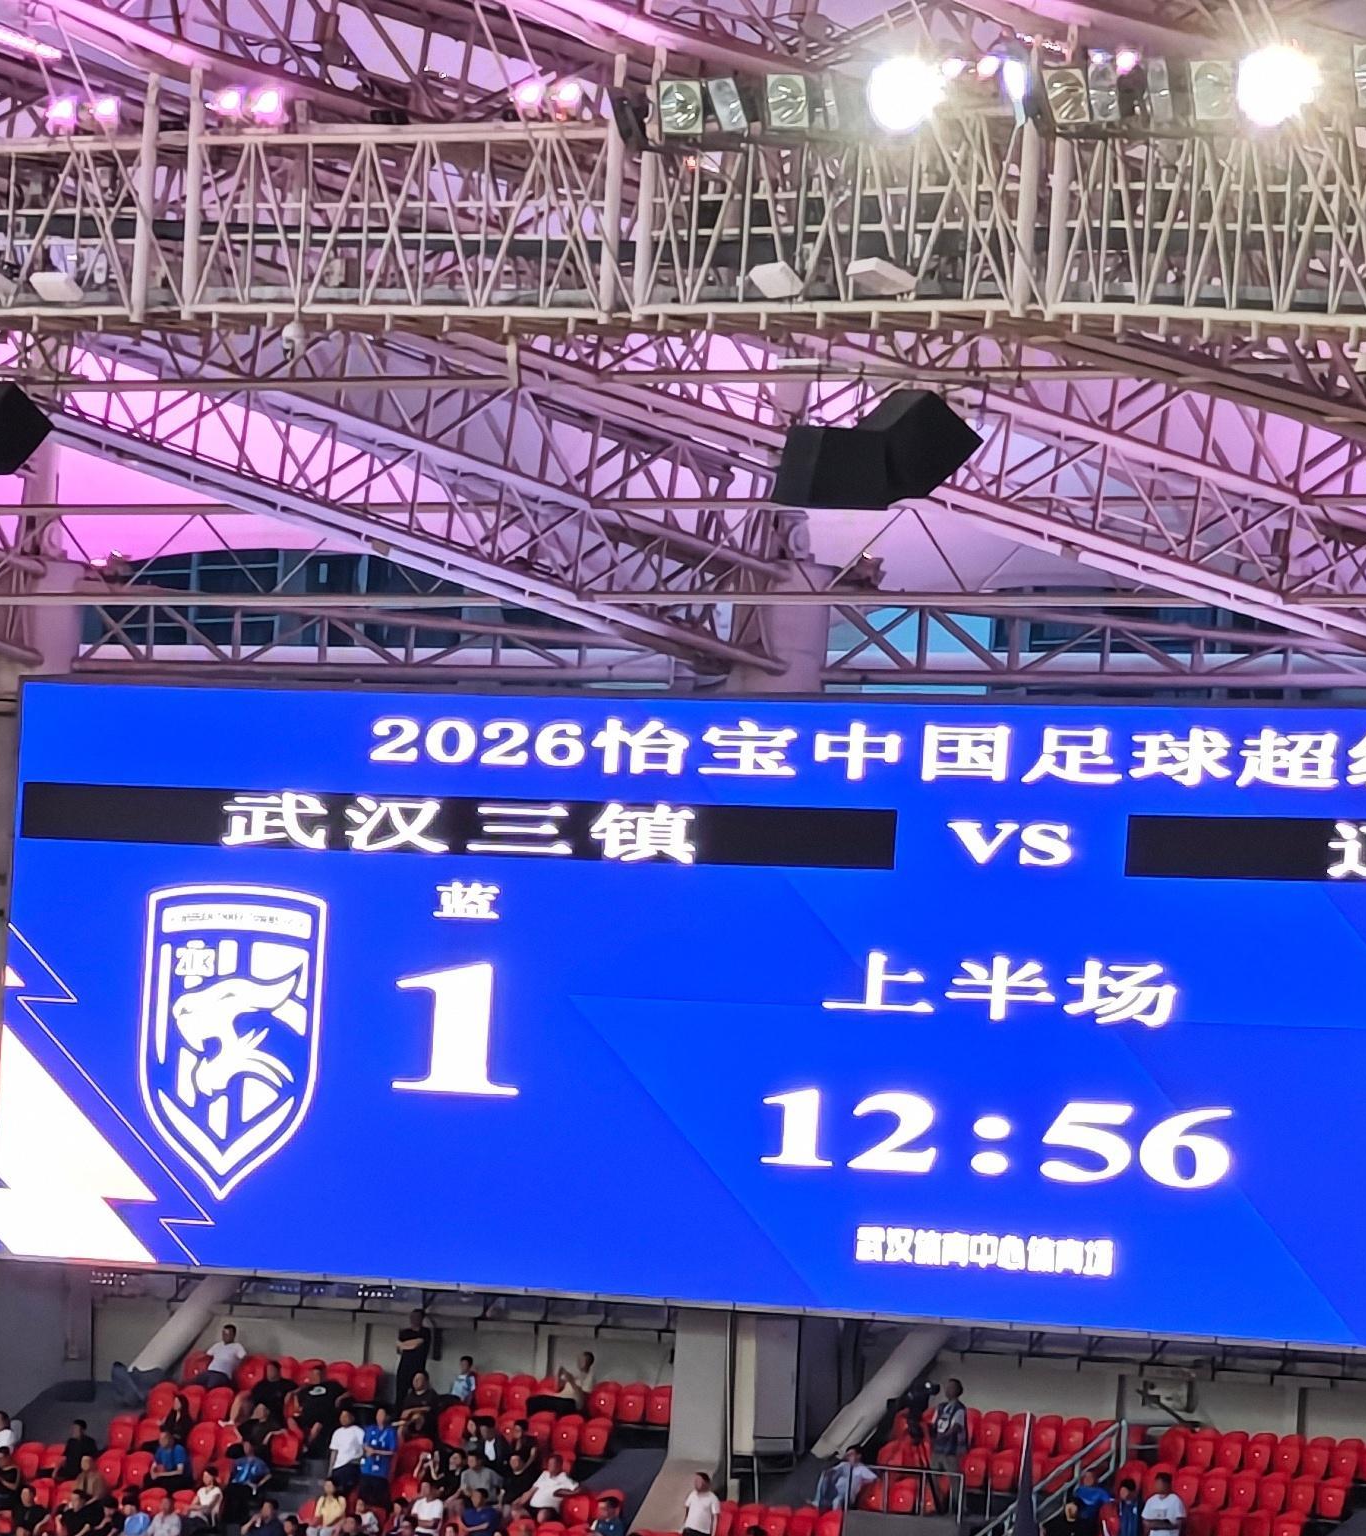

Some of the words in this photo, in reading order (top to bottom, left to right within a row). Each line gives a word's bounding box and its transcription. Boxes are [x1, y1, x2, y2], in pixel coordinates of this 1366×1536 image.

[221, 790, 697, 866] 武汉三镇
[947, 819, 1073, 867] VS
[433, 880, 501, 921] 蓝
[821, 951, 1178, 1028] 上半场
[392, 961, 519, 1096] 1
[759, 1086, 1234, 1190] 12:56
